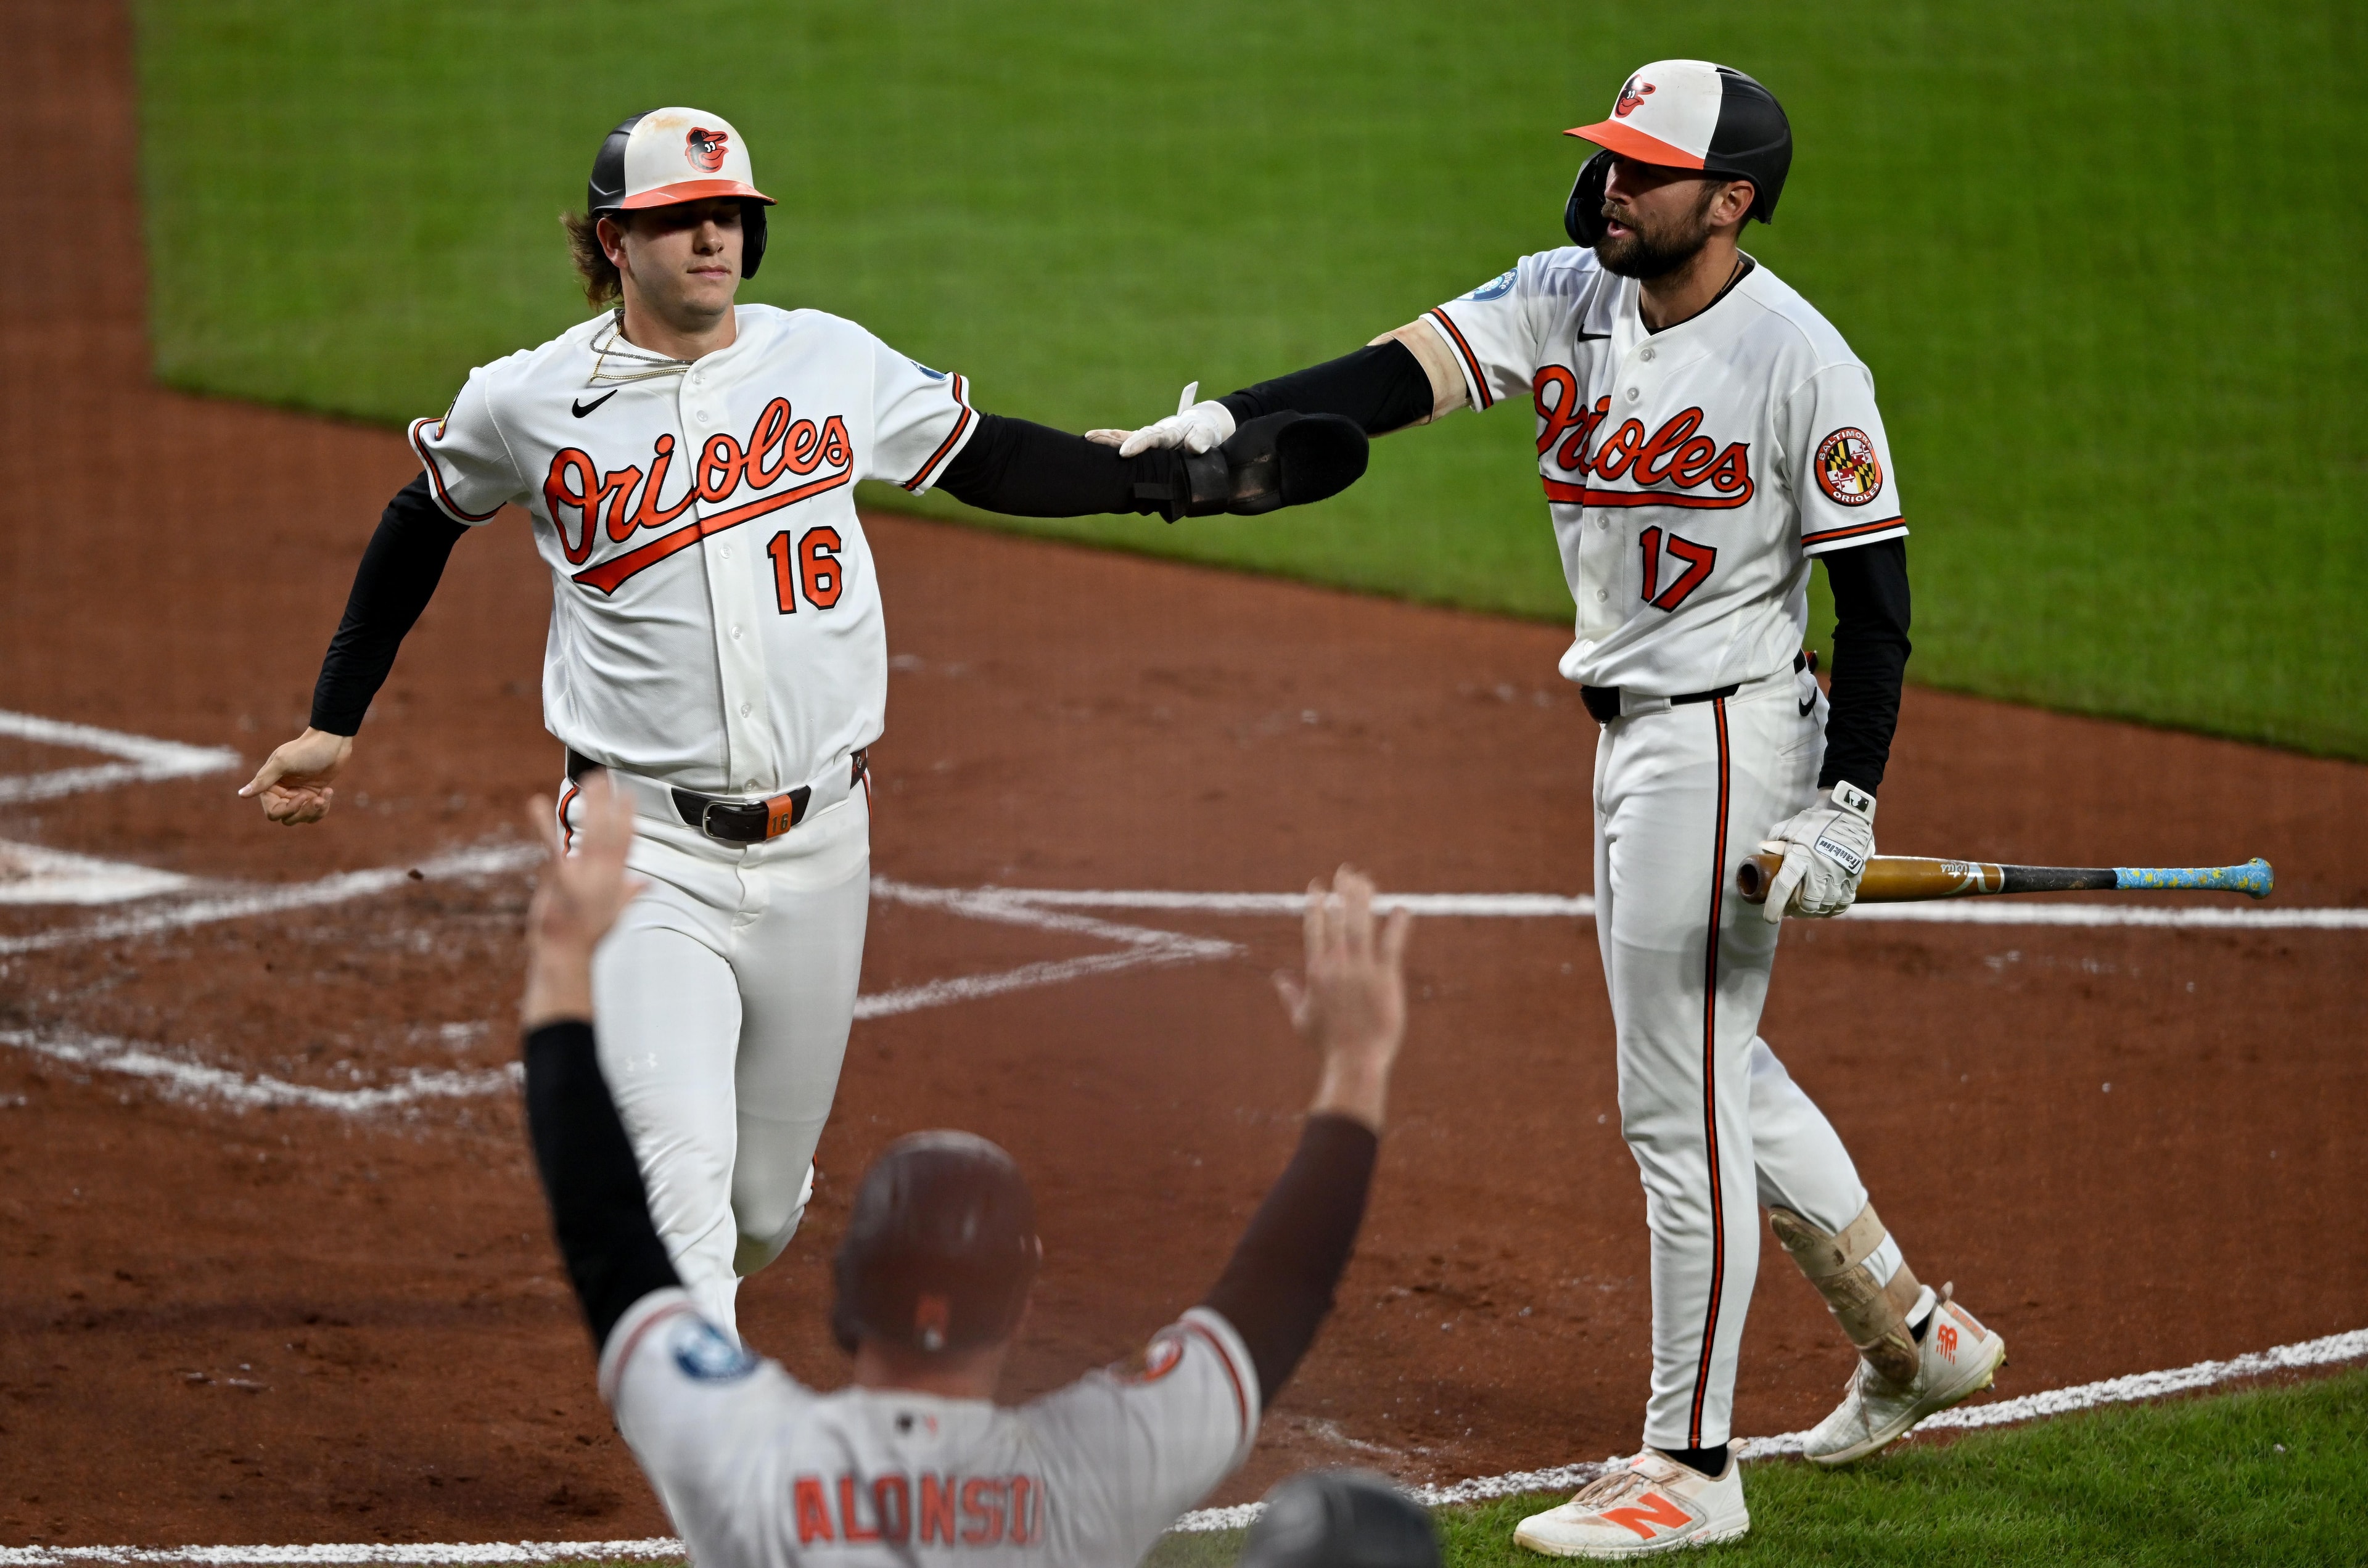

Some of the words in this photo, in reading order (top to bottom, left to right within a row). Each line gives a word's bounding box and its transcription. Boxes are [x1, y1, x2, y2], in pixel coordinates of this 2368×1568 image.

[543, 396, 853, 565] Orioles
[1833, 482, 1879, 502] ORIOLES
[767, 526, 843, 615] 16
[1639, 525, 1717, 612] 17
[772, 812, 789, 833] 16
